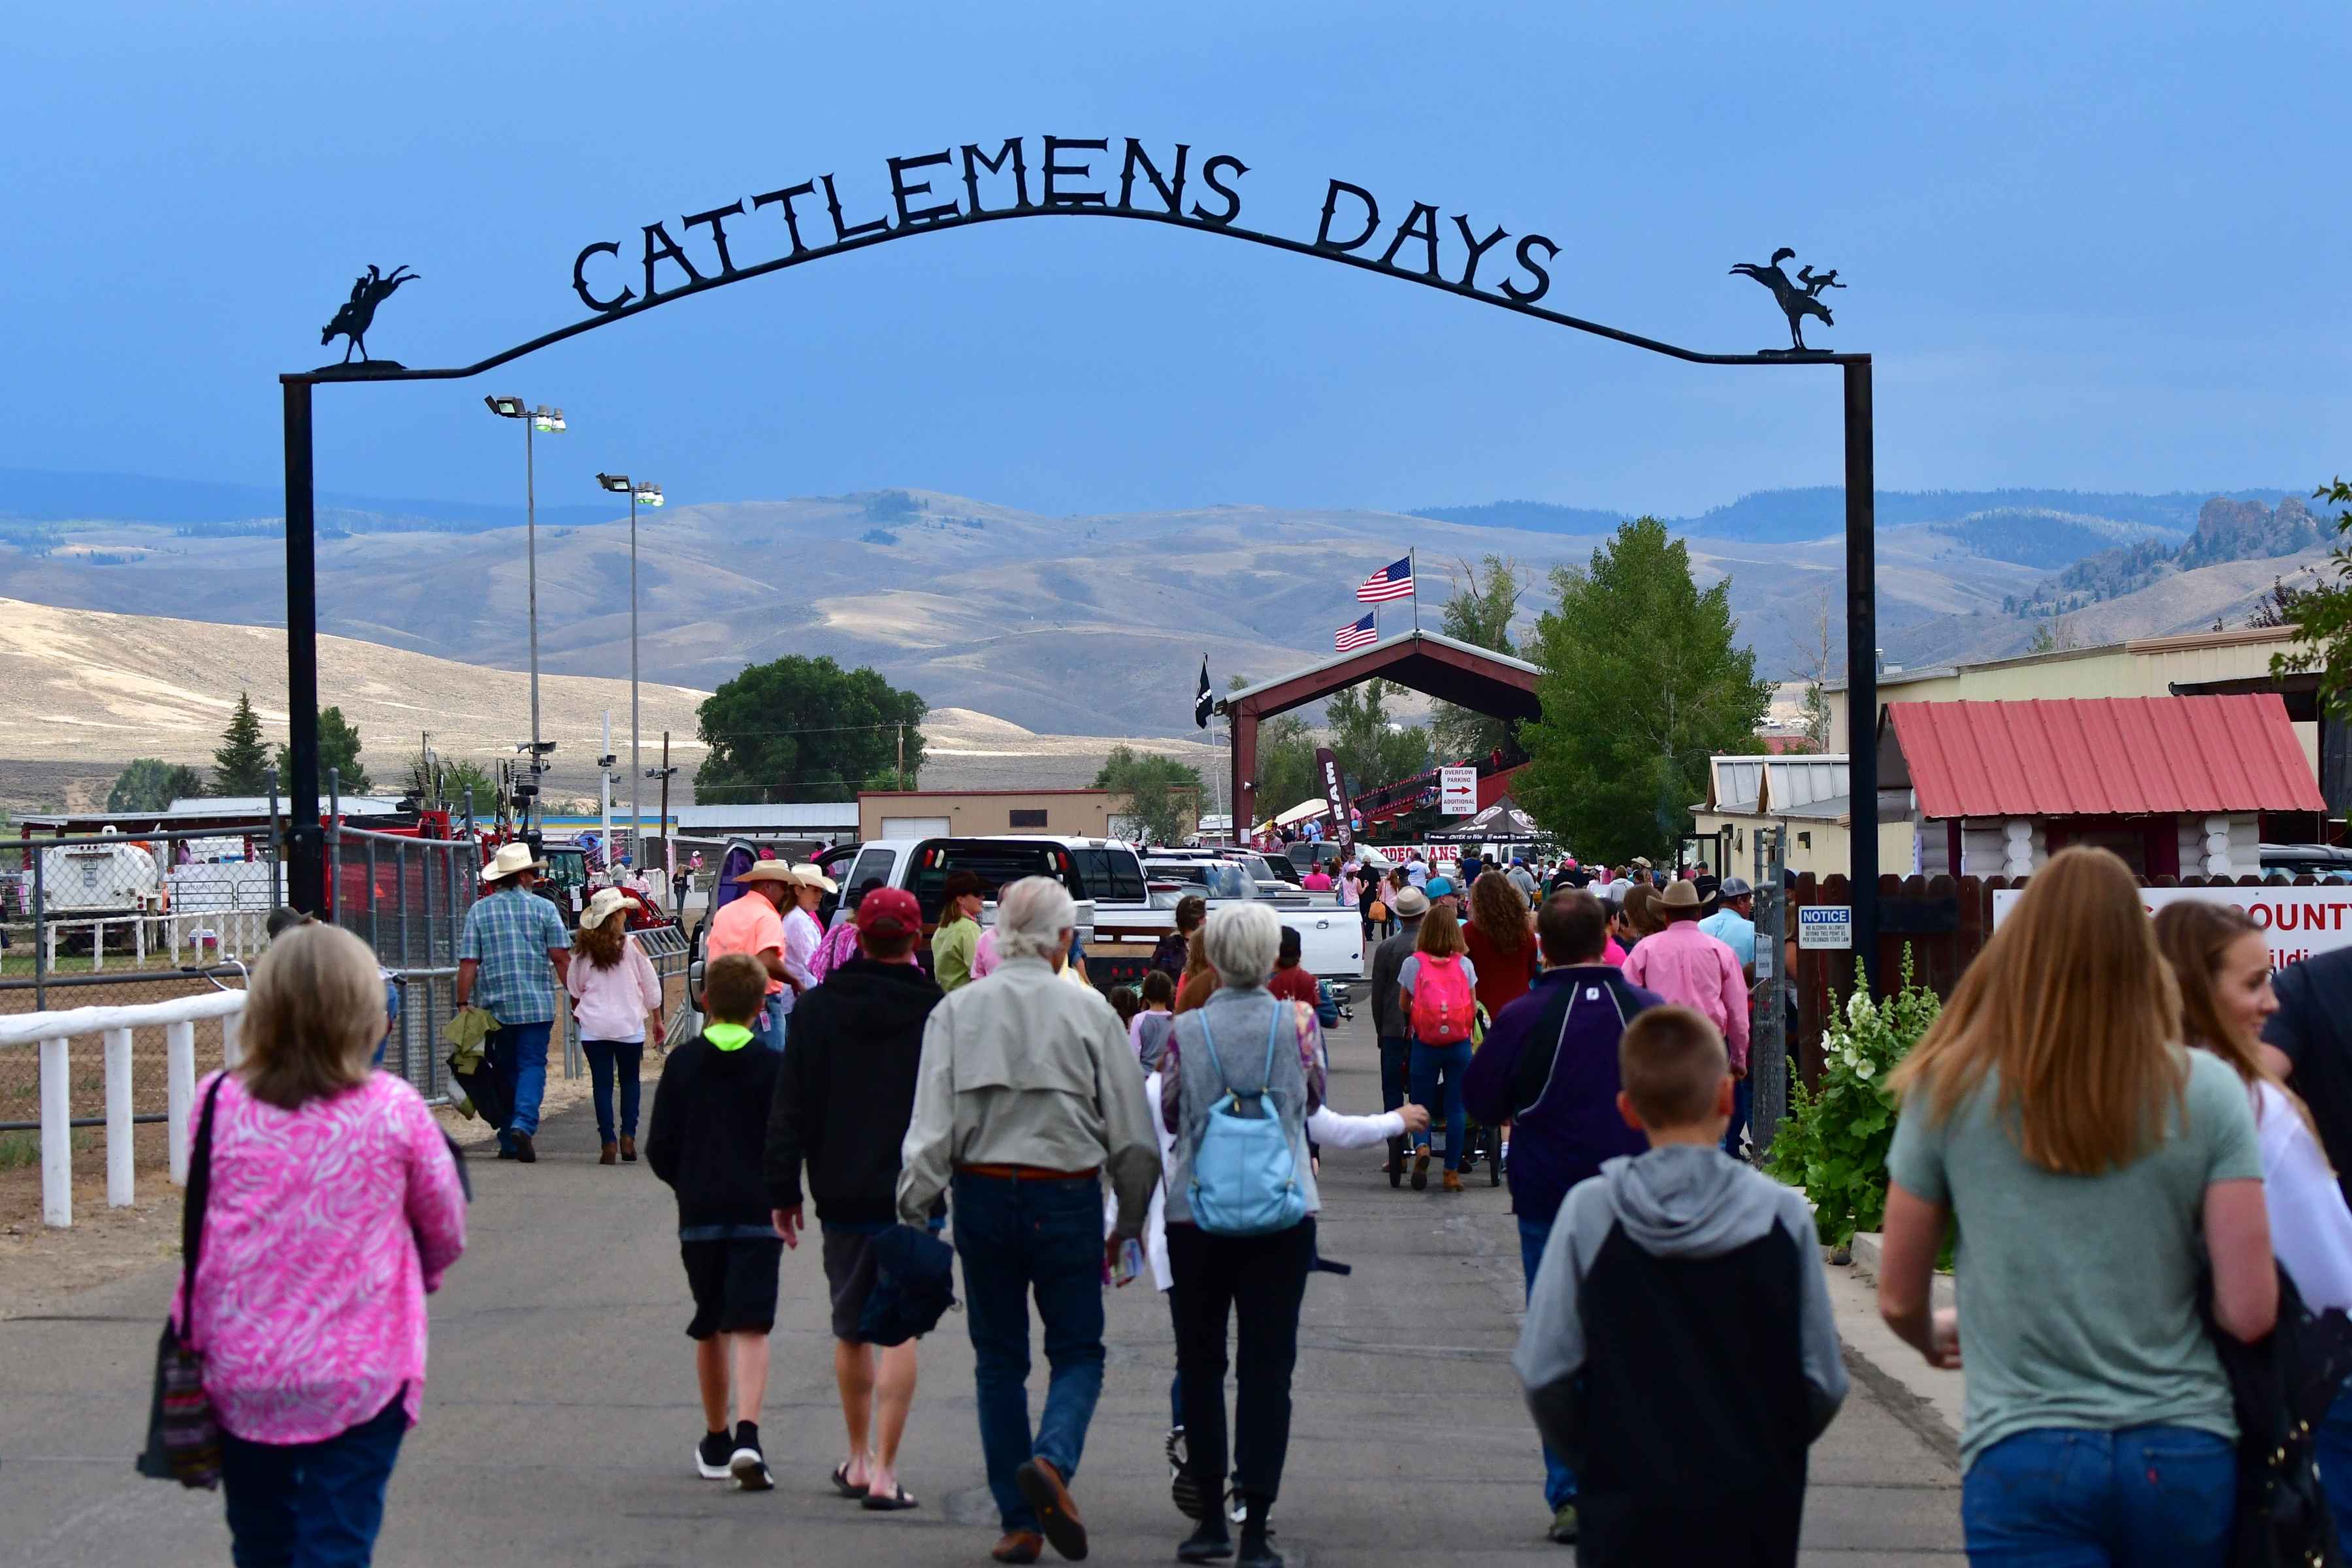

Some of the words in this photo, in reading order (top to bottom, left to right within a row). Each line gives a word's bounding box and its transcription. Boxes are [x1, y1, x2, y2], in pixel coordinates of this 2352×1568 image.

[572, 135, 1251, 312] CATTLEMENS
[1313, 178, 1563, 304] DAYS
[1325, 761, 1345, 821] RAM
[1803, 911, 1847, 923] NOTICE
[2229, 903, 2352, 931] OUNT
